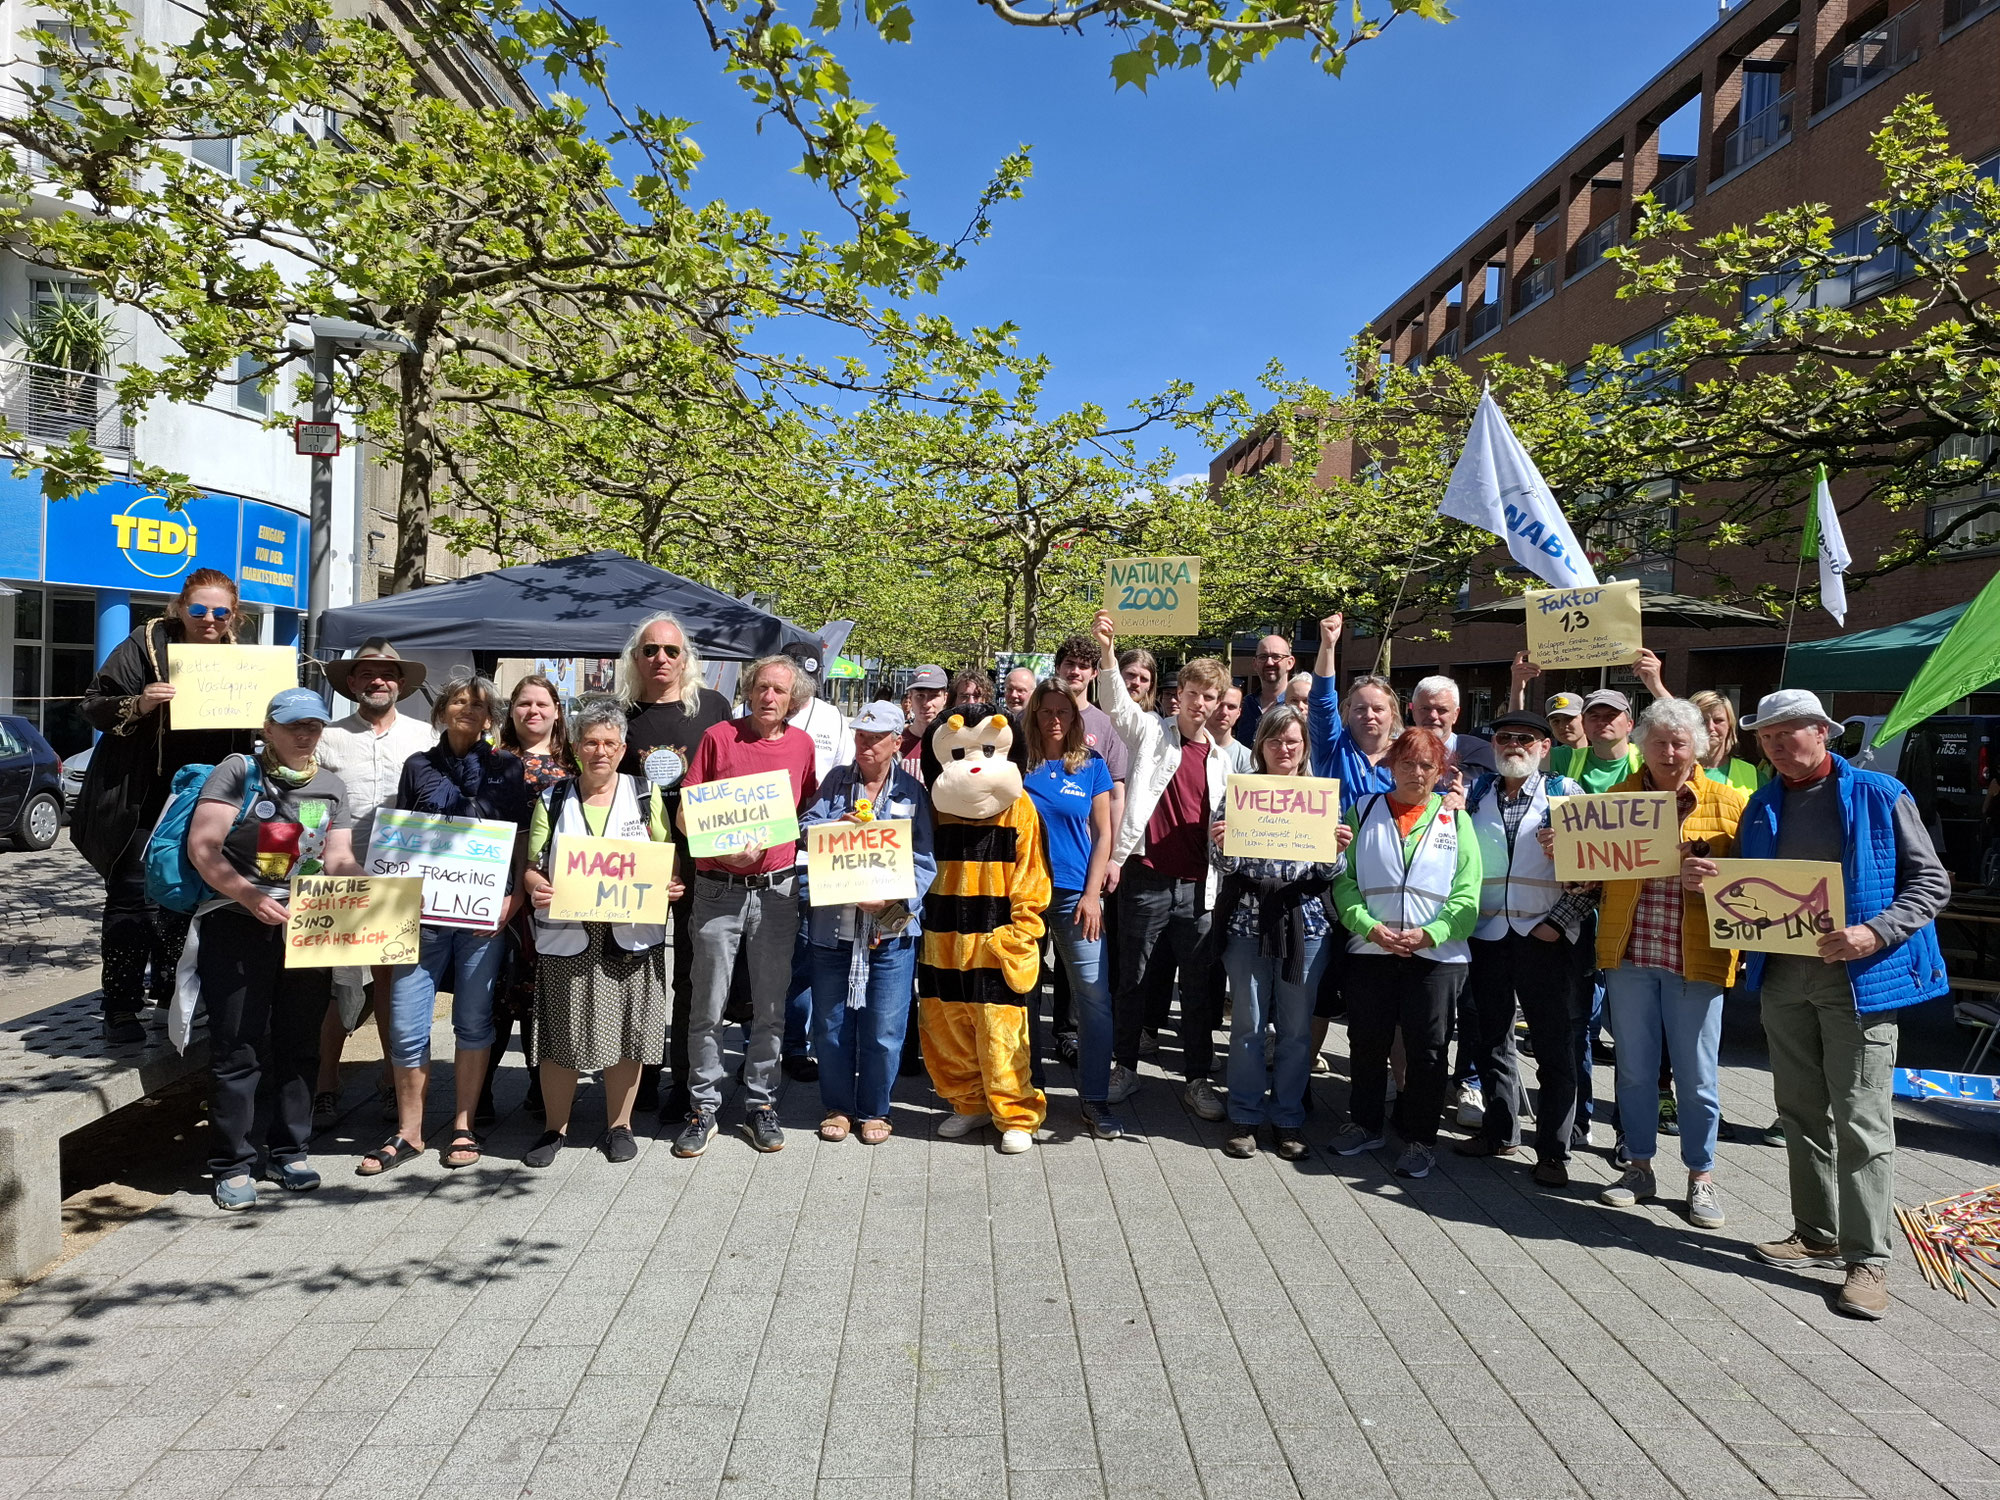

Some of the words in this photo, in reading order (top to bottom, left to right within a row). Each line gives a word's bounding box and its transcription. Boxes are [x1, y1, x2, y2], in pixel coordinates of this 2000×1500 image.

[111, 514, 198, 557] TEDi
[258, 525, 286, 544] EINGANG
[255, 546, 268, 561] VON
[269, 550, 284, 565] DER
[1110, 561, 1191, 587] NATURA
[1118, 586, 1178, 611] 2000
[1536, 589, 1607, 615] Faktor
[1559, 610, 1590, 633] 1,3
[687, 782, 733, 805] NEUE
[734, 783, 780, 805] GASE
[1064, 788, 1086, 798] NABU
[1234, 785, 1334, 817] VIELFALT
[624, 819, 643, 827] OMA
[698, 803, 770, 832] WIRKLICH
[1560, 798, 1668, 833] HALTET
[377, 826, 422, 848] SAVE
[466, 840, 502, 859] SEAS
[818, 828, 901, 854] IMMER
[372, 859, 410, 876] STOP
[567, 850, 637, 880] MACH
[832, 849, 897, 872] MEHR?
[1576, 839, 1660, 873] INNE
[296, 878, 371, 897] MANCHE
[595, 880, 653, 911] MIT
[431, 890, 491, 917] LNG
[291, 914, 335, 930] SIND
[1714, 918, 1773, 940] STOP
[1783, 909, 1835, 940] LNG
